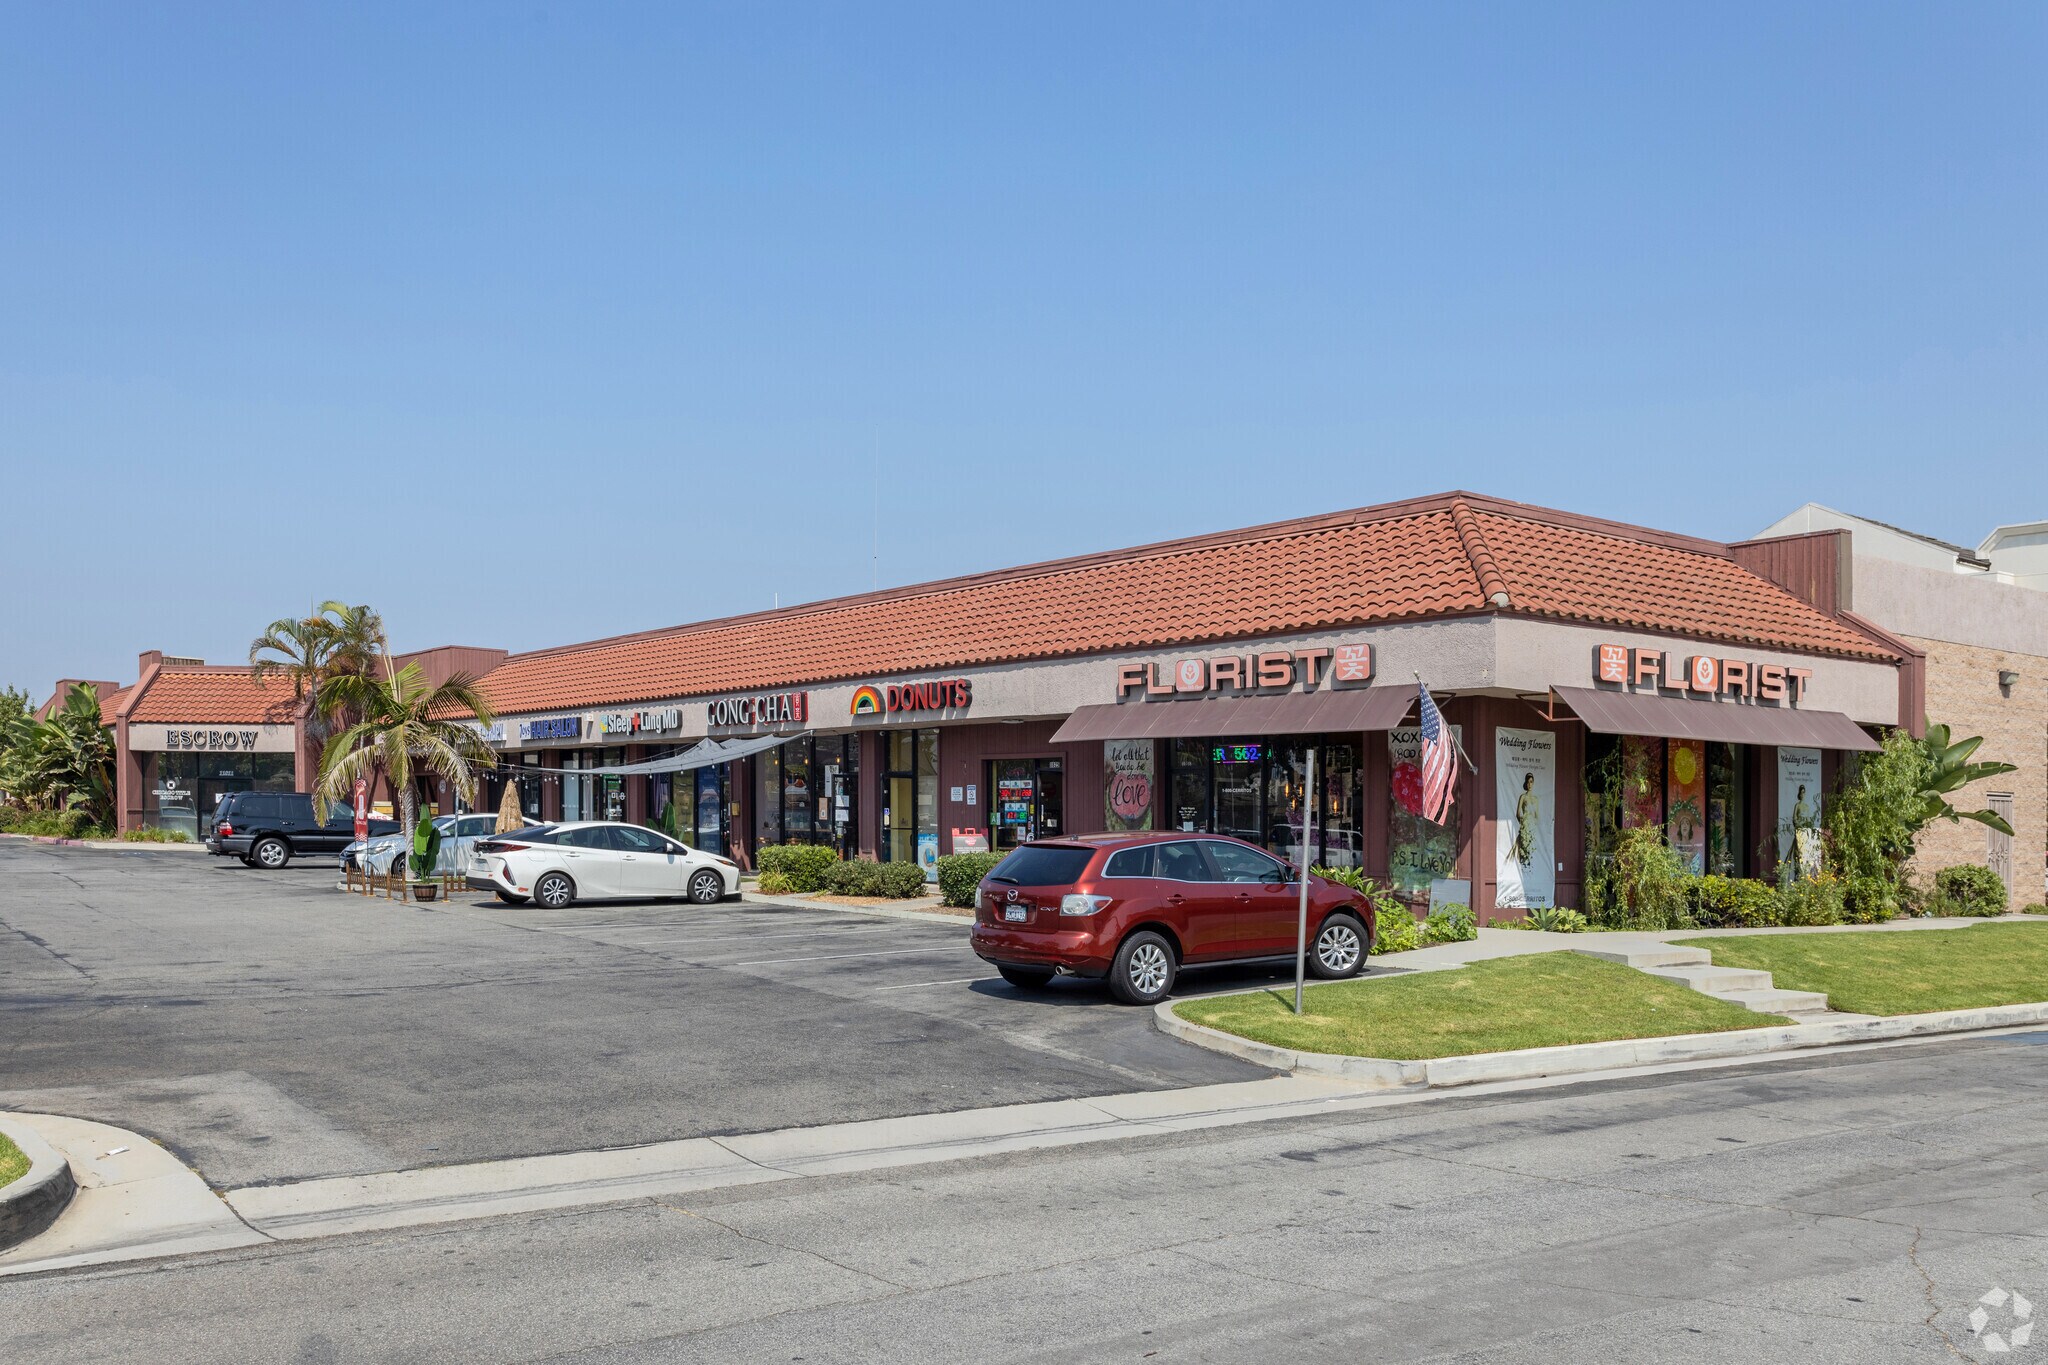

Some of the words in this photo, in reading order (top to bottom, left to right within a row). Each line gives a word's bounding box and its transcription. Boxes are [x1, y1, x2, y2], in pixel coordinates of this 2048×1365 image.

[1118, 648, 1329, 696] FLORIST
[1337, 645, 1368, 678] 꽃
[1601, 646, 1626, 680] 꽃
[1634, 648, 1812, 702] FLORIST
[706, 699, 749, 725] GONG
[756, 695, 792, 722] CHA
[887, 678, 967, 712] DONUTS
[531, 719, 549, 739] HAIR
[551, 717, 578, 737] SALON
[608, 714, 632, 735] Sleep
[640, 711, 662, 734] Lung
[663, 709, 678, 728] MD
[166, 730, 257, 746] ESCROW
[1391, 732, 1422, 744] XOX
[1499, 736, 1527, 751] Wedding
[1528, 739, 1552, 750] Flowers
